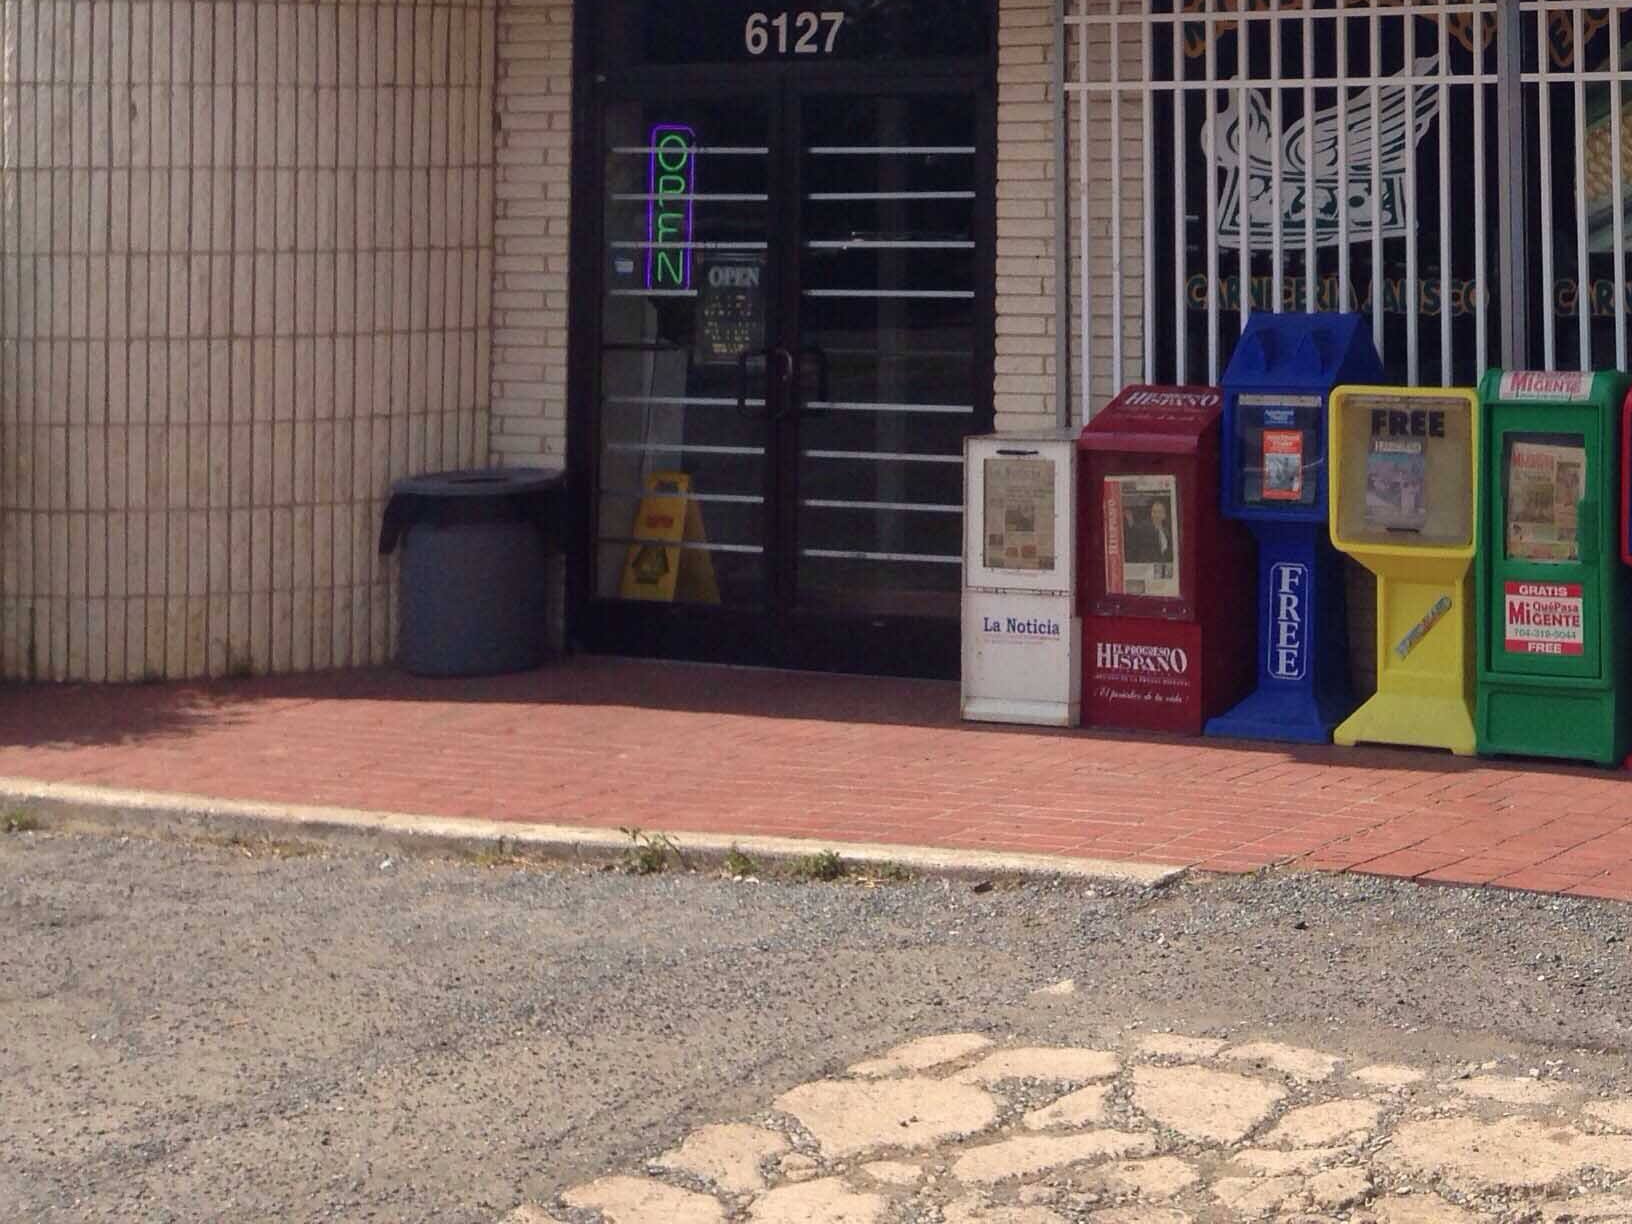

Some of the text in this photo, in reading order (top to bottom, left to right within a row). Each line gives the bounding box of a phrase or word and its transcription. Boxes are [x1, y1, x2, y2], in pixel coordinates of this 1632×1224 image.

[745, 11, 845, 55] 6127
[657, 134, 688, 286] OPEN
[708, 266, 760, 287] OPEN
[1371, 407, 1445, 438] FREE
[1519, 584, 1568, 597] GRATIS
[983, 616, 1061, 636] La Noticia
[1276, 566, 1303, 677] FREE
[1532, 614, 1581, 628] GENTE
[1096, 642, 1188, 673] HISPANO
[1527, 641, 1563, 654] FREE
